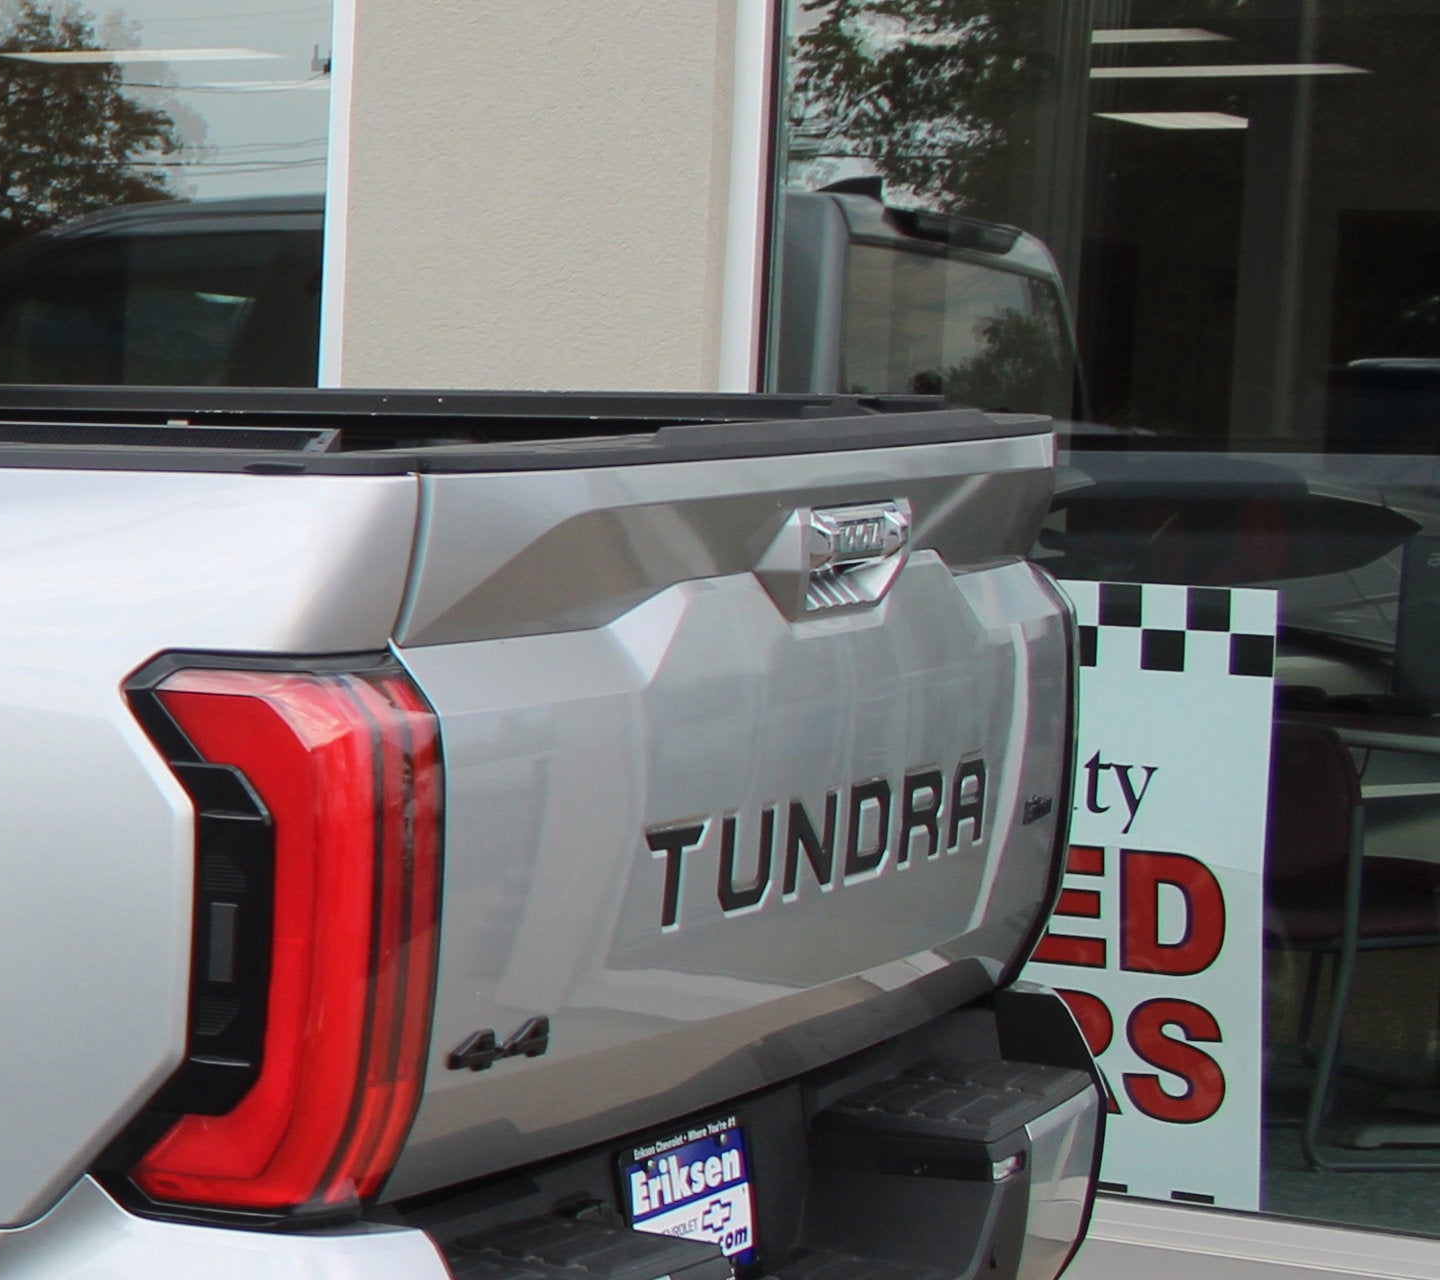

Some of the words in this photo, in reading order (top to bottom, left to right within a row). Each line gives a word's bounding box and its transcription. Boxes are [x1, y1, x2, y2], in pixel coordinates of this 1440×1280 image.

[1074, 748, 1160, 835] ty
[644, 756, 989, 932] TUNDRA
[630, 1148, 742, 1217] Eriksen
